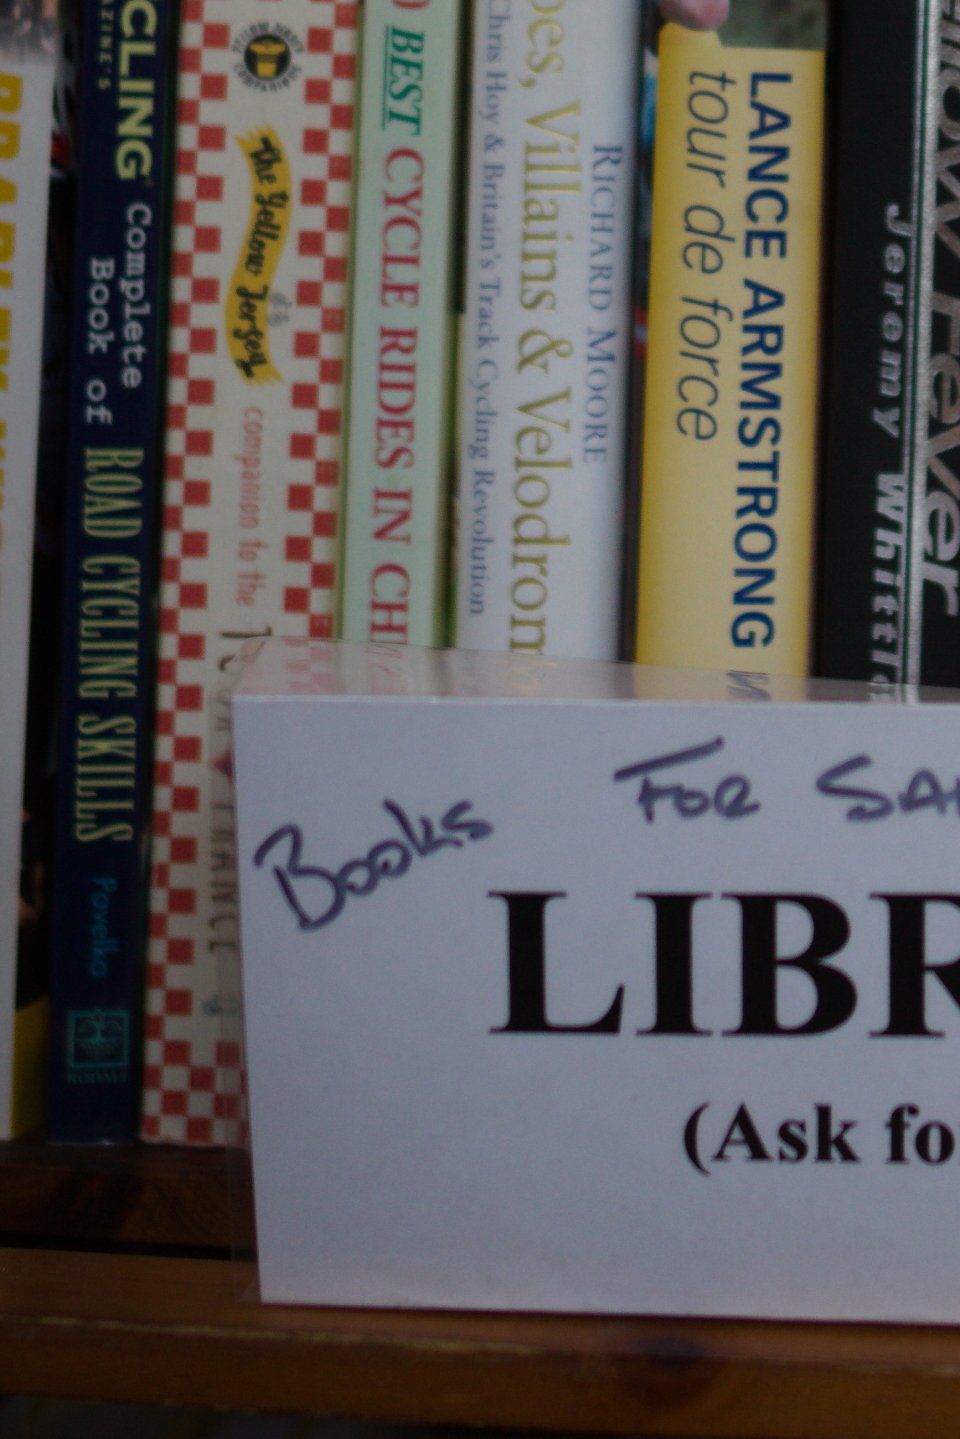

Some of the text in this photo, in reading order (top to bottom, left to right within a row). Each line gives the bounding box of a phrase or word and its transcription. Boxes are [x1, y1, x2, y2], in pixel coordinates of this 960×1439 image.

[384, 25, 426, 136] BEST
[478, 70, 509, 125] Hoy
[242, 189, 289, 277] Yellow
[378, 148, 424, 308] CYCLE
[477, 162, 507, 271] Britain's
[518, 95, 583, 311] Villains
[743, 70, 792, 259] LANCE
[117, 200, 154, 390] Complete
[475, 280, 501, 350] Track
[580, 143, 624, 465] RICHARD MOORE
[674, 70, 738, 442] tour de force
[872, 203, 914, 440] Jeremy
[85, 256, 116, 425] Book of
[232, 284, 273, 378] Jersey
[373, 323, 419, 471] RIDES
[515, 328, 574, 376] &
[234, 408, 266, 530] companion
[468, 359, 498, 460] Cycling
[730, 277, 787, 649] ARMSTRONG
[371, 486, 414, 547] IN
[467, 468, 494, 616] Revolution
[75, 447, 145, 843] ROAD CYCLING SKILLS
[253, 798, 494, 932] Books
[682, 1101, 863, 1177] (Ask
